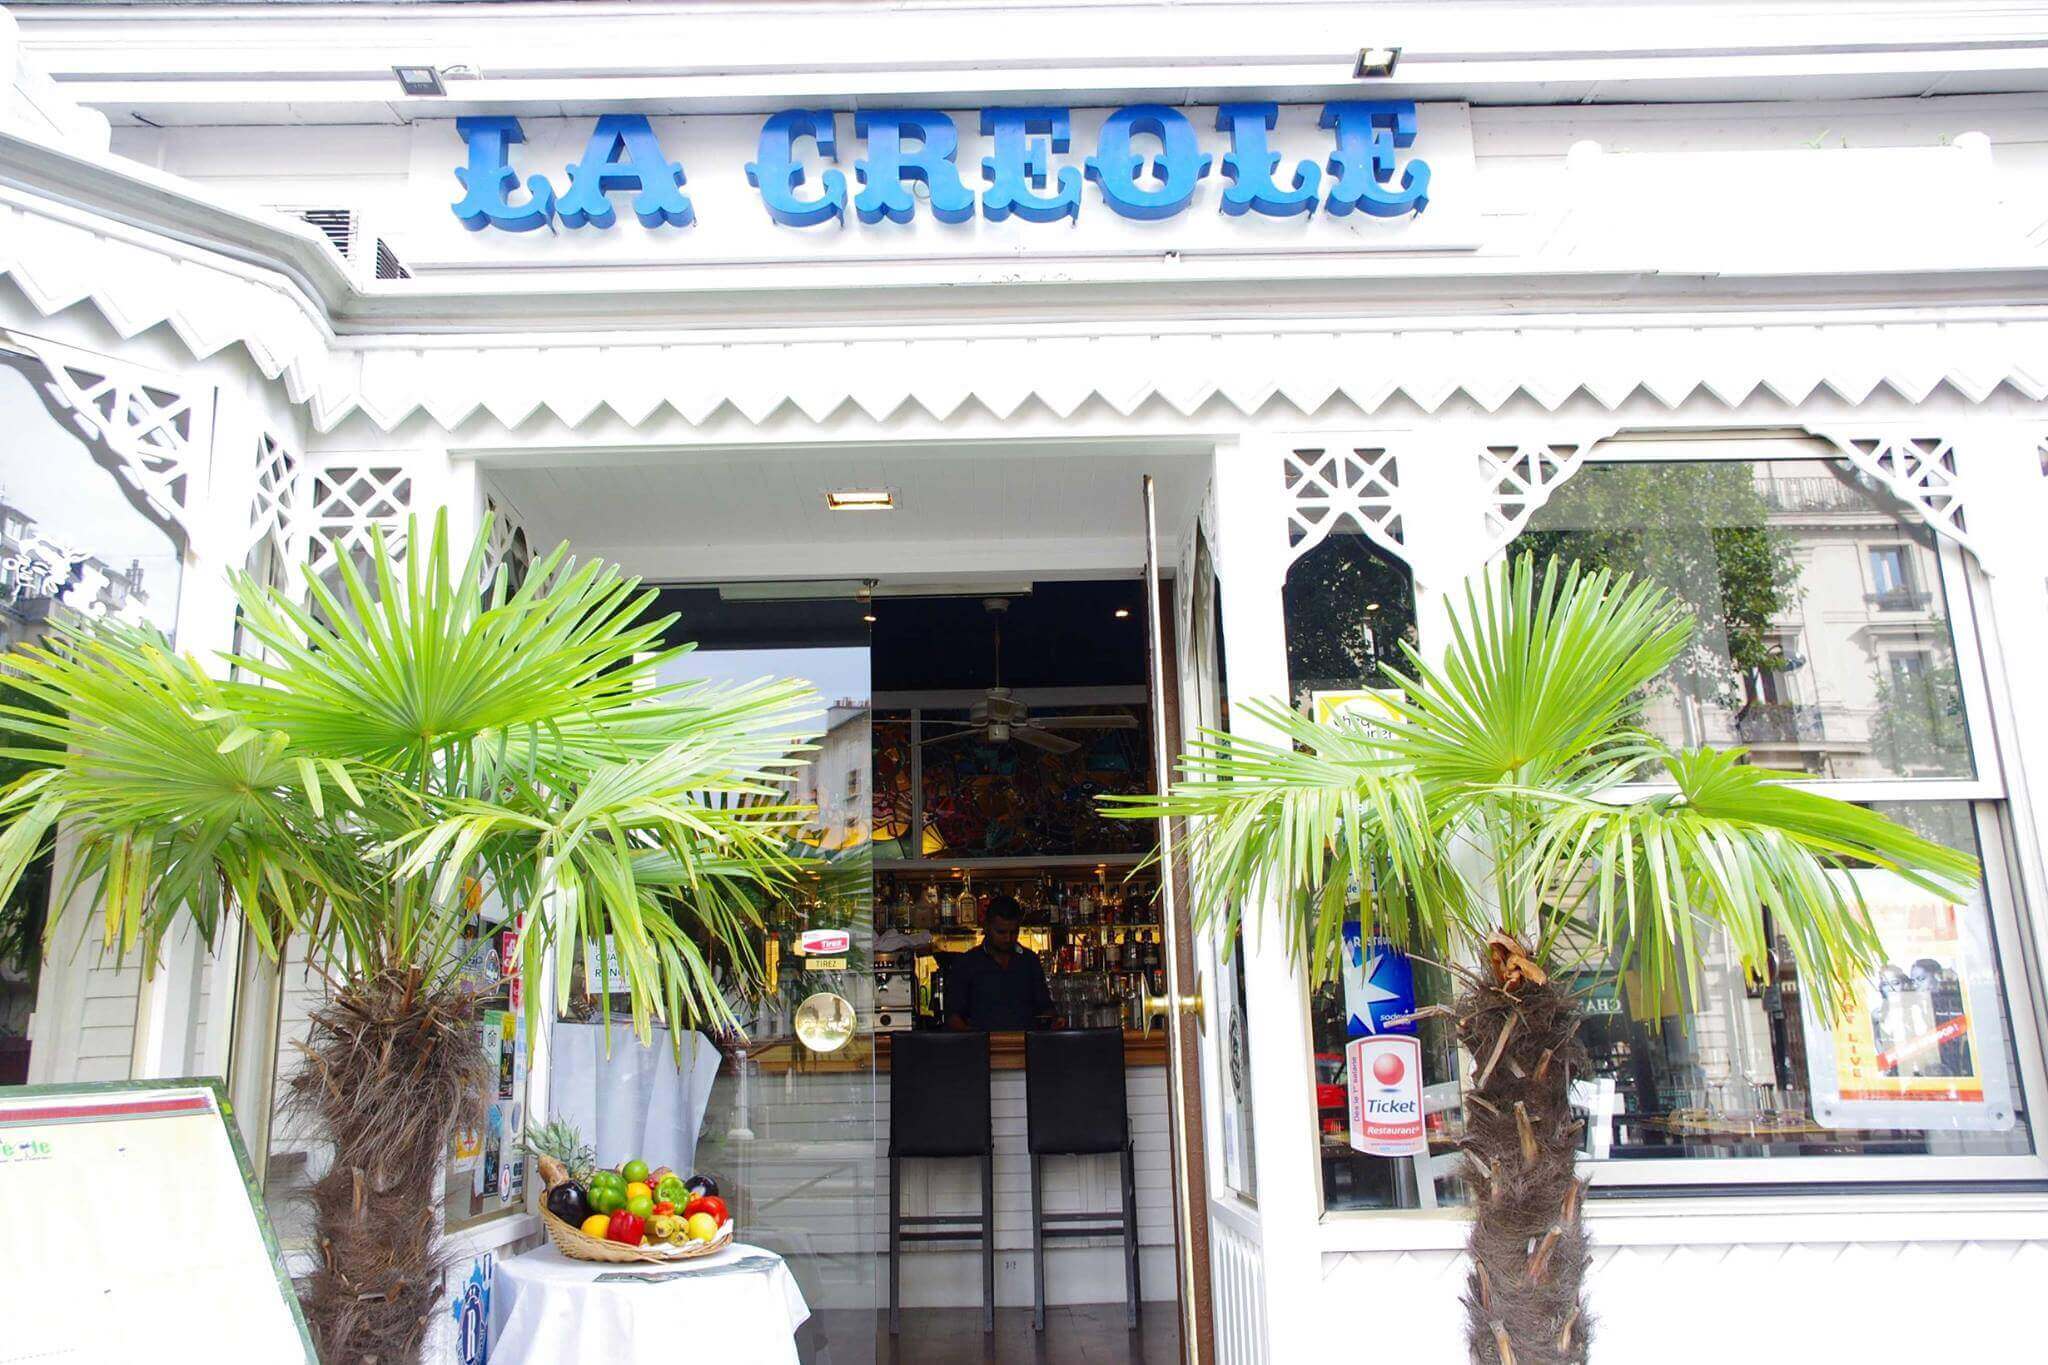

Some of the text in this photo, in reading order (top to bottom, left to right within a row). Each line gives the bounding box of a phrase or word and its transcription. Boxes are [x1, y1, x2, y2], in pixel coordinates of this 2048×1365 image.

[451, 98, 1432, 234] LA CREOLE
[815, 960, 838, 968] TIREZ
[1368, 1100, 1416, 1113] Ticket
